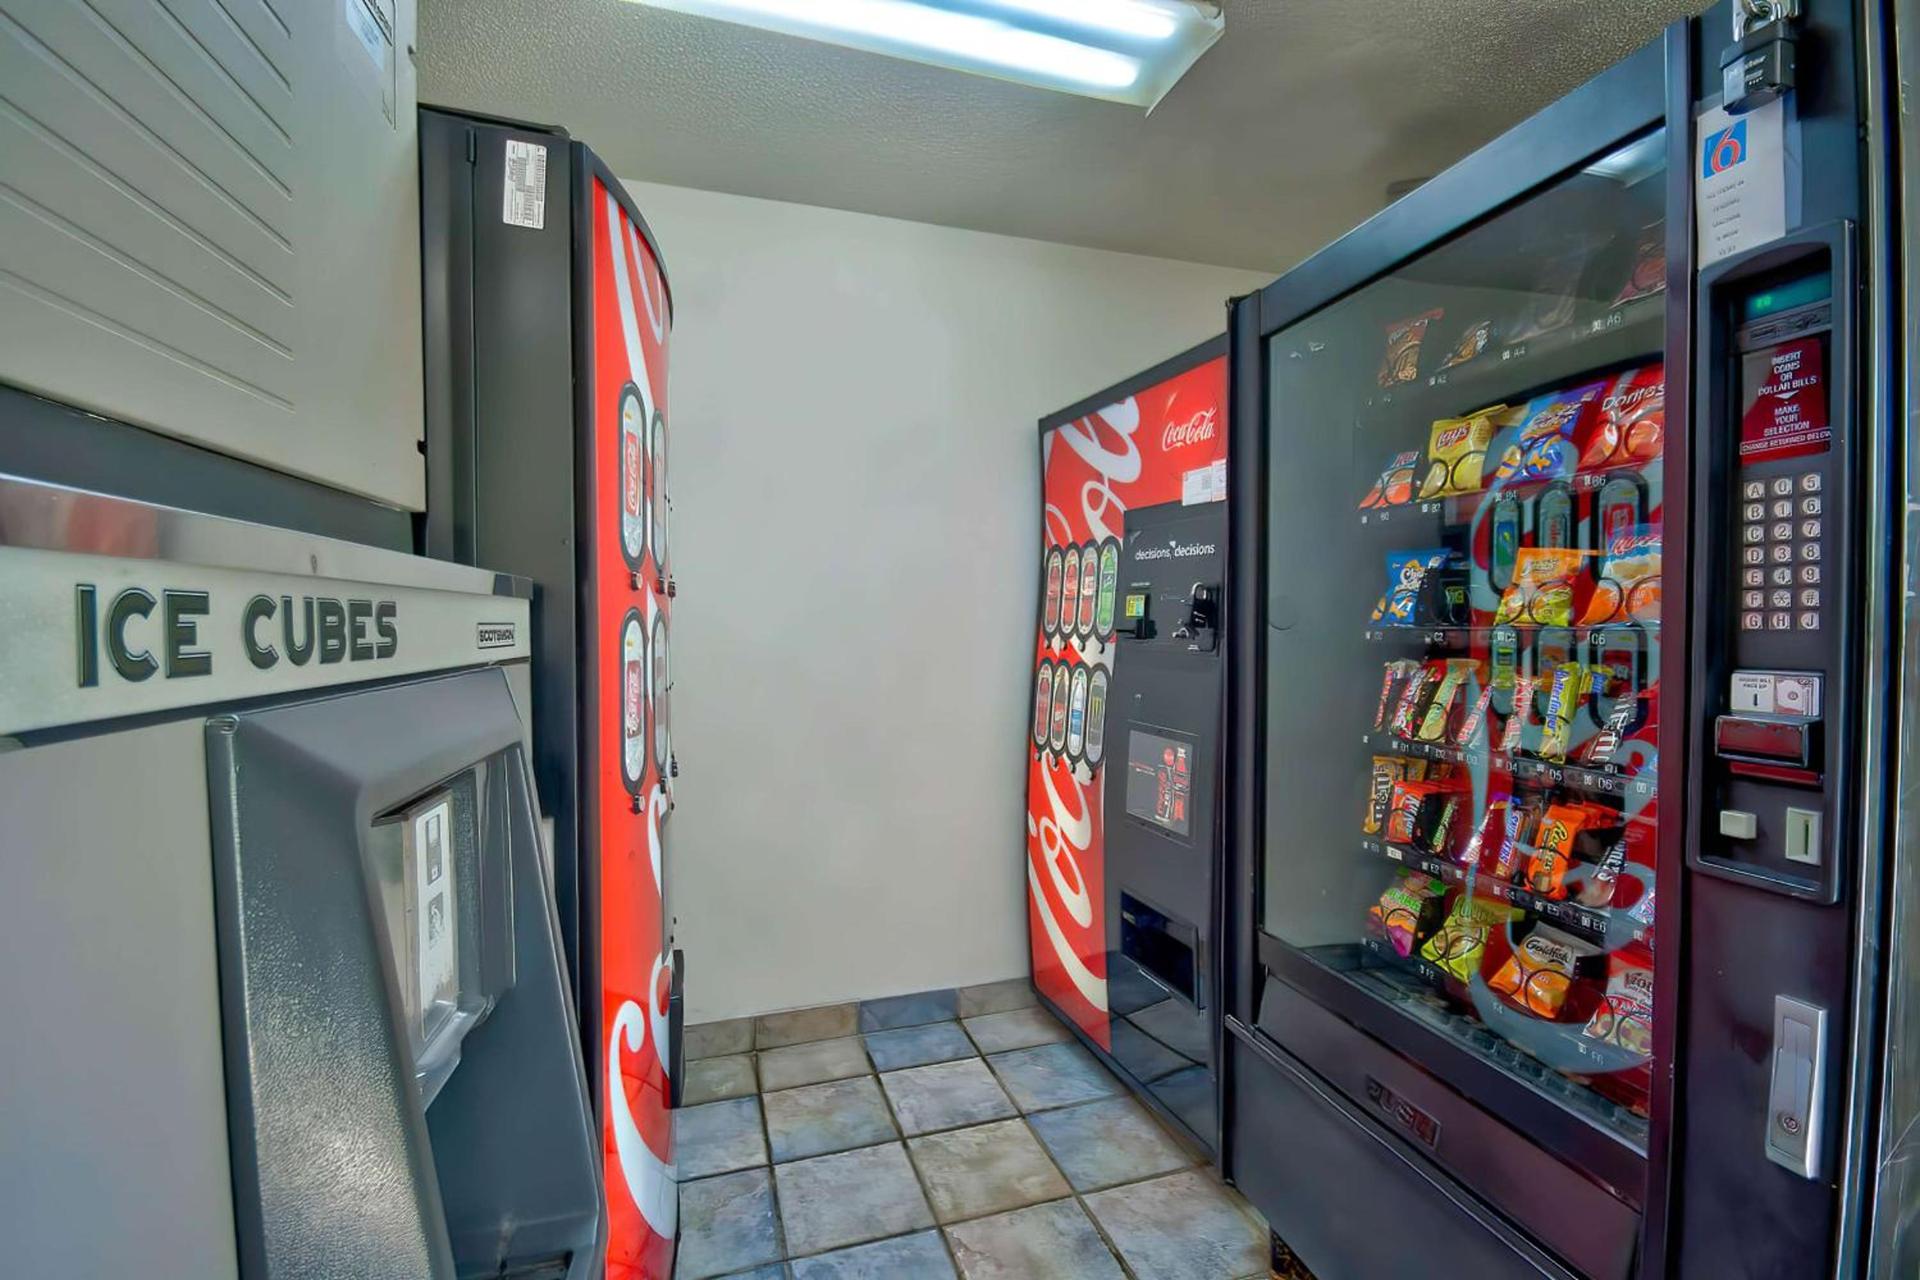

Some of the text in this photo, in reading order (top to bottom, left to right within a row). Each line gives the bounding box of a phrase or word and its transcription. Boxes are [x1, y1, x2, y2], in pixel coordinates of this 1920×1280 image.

[1771, 350, 1803, 365] INSERT
[1773, 361, 1800, 375] COINS
[1780, 371, 1793, 382] OR
[1758, 375, 1817, 397] DOLLAR BILLS
[1774, 404, 1800, 416] MAKE
[1774, 413, 1799, 426] YOUR
[1162, 407, 1216, 452] Coca-Cola
[1763, 421, 1810, 437] SELECTION
[1174, 543, 1216, 558] decisions
[75, 582, 398, 688] ICE CUBES
[1526, 939, 1570, 963] Goldfish
